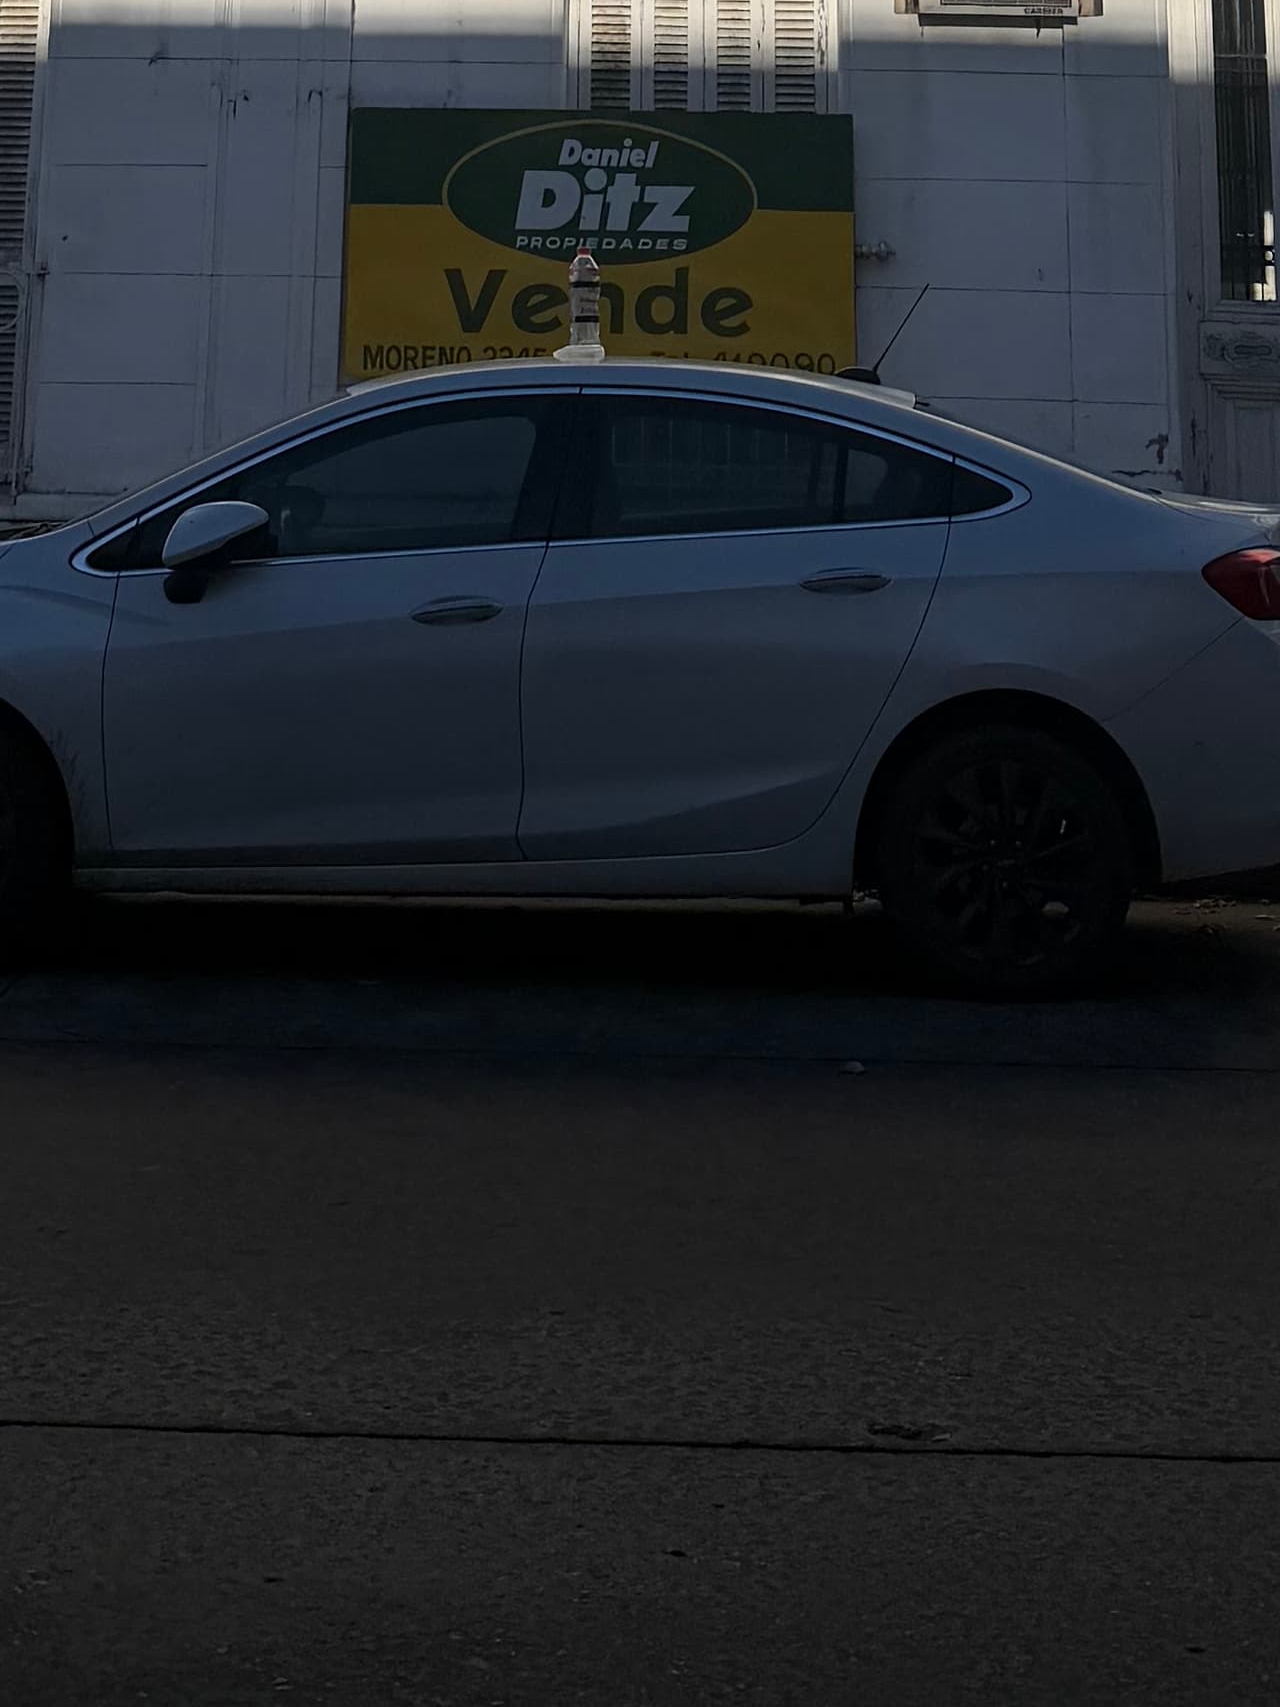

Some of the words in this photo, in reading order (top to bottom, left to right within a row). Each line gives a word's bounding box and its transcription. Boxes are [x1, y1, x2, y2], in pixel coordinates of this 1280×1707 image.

[558, 138, 660, 169] Daniel
[515, 168, 696, 232] Ditz
[516, 236, 688, 251] PROPIEDADES
[444, 266, 754, 337] Vende
[362, 344, 471, 371] MORENO
[713, 352, 836, 375] 090
